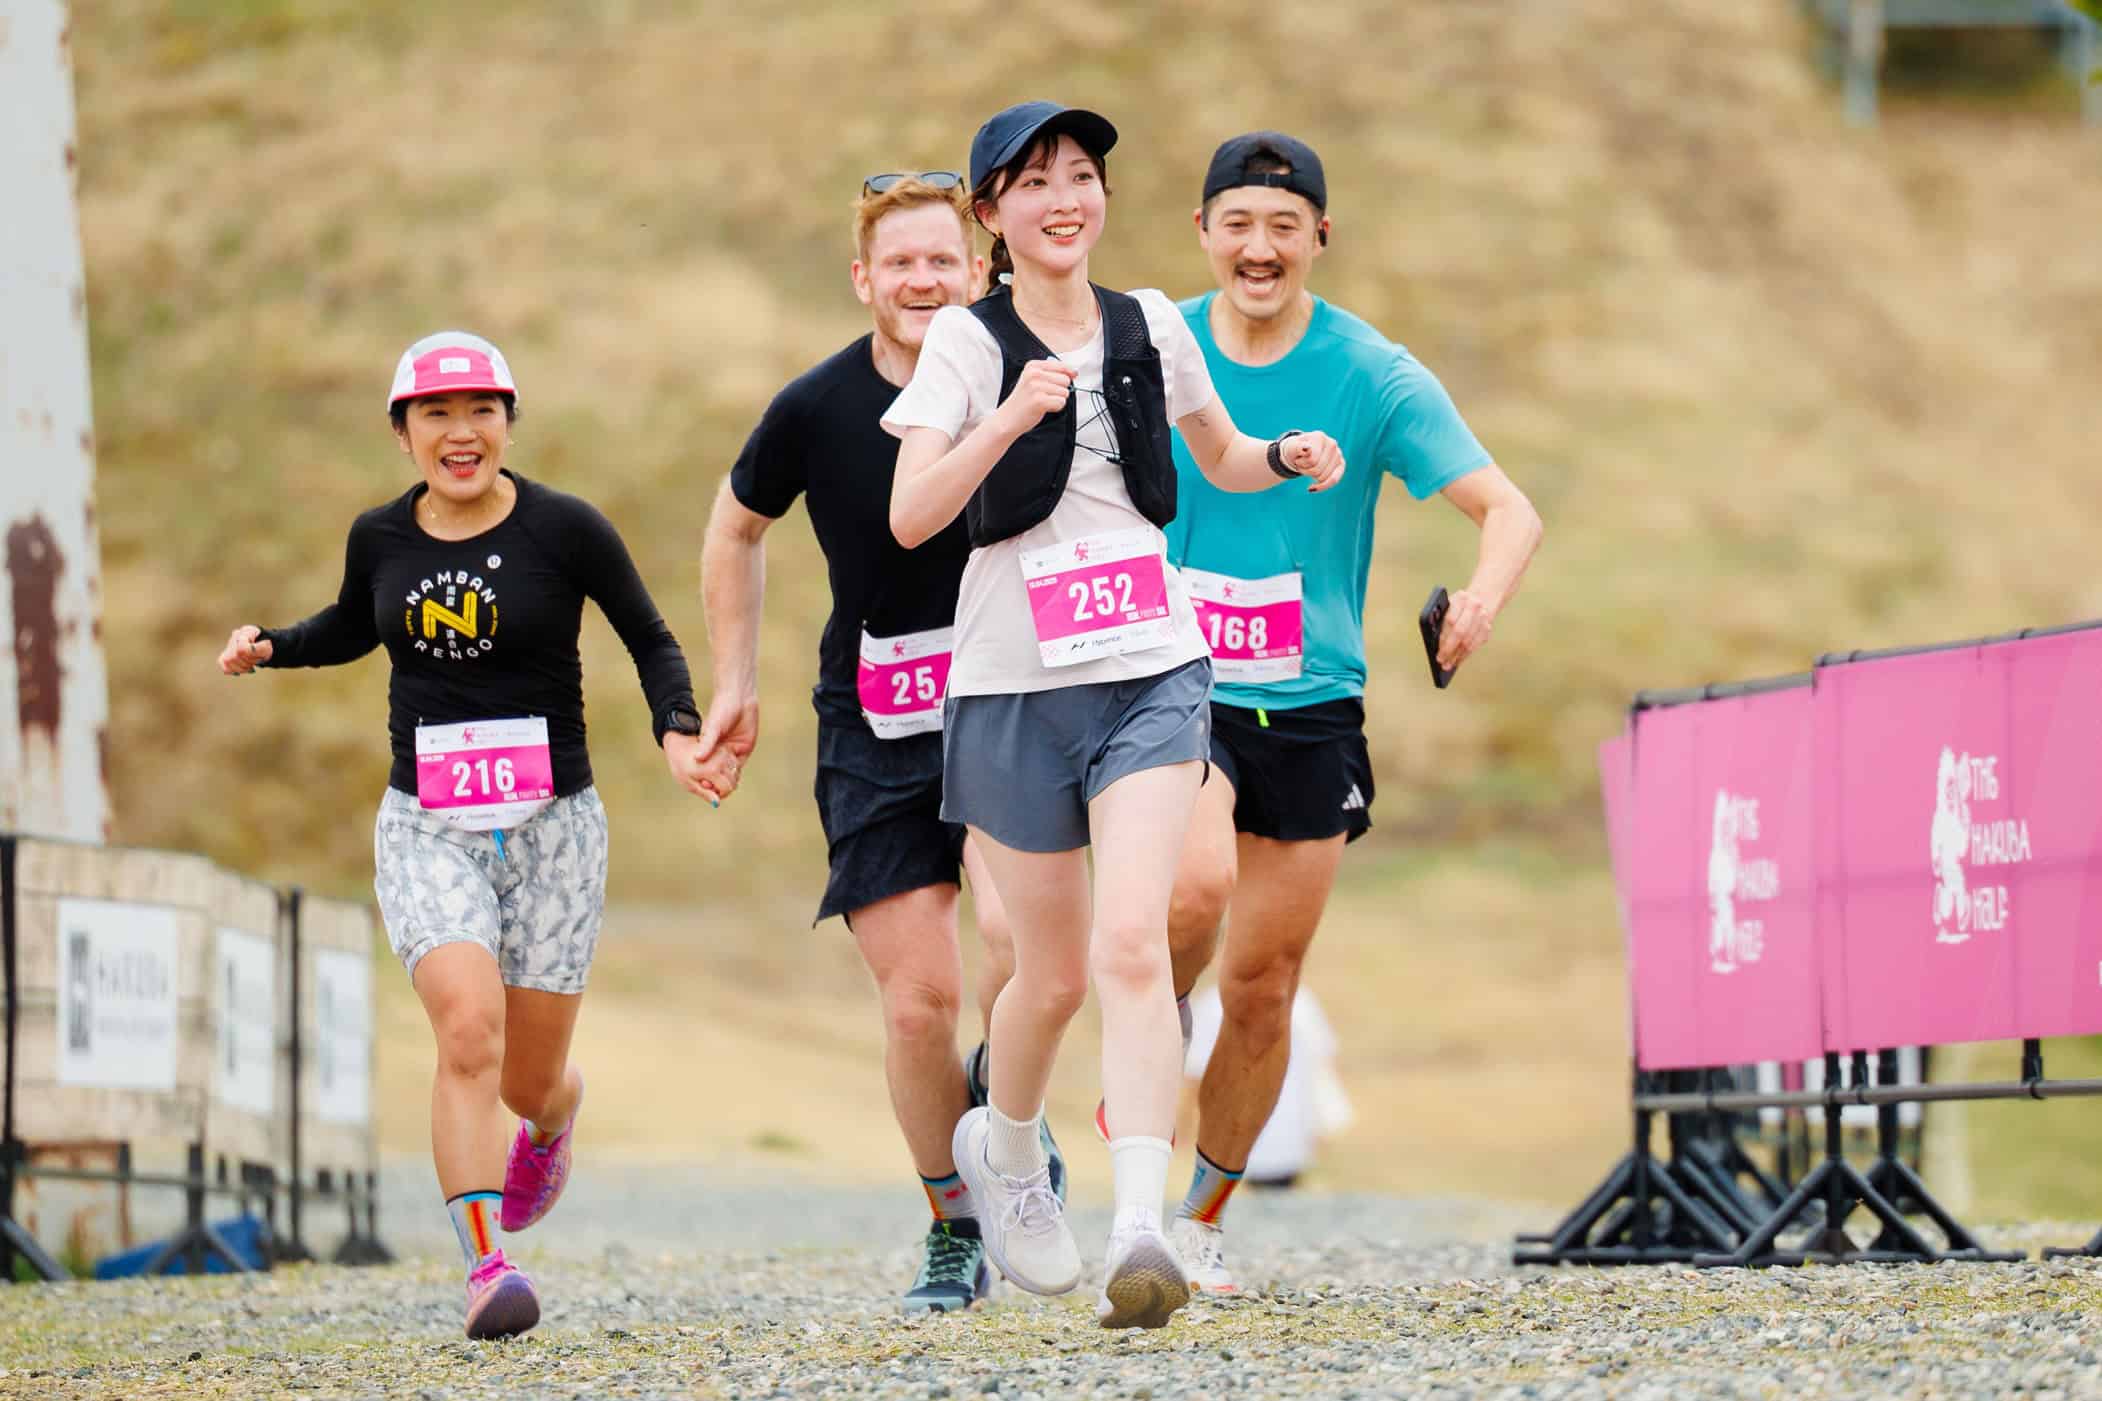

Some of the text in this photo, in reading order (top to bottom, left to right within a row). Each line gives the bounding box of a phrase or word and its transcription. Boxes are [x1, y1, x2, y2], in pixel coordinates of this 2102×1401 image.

[406, 570, 497, 606] NAMBAN
[1068, 572, 1137, 622] 252
[414, 639, 493, 660] RENGO
[1208, 612, 1268, 651] 168
[891, 665, 936, 706] 25
[452, 757, 516, 797] 216
